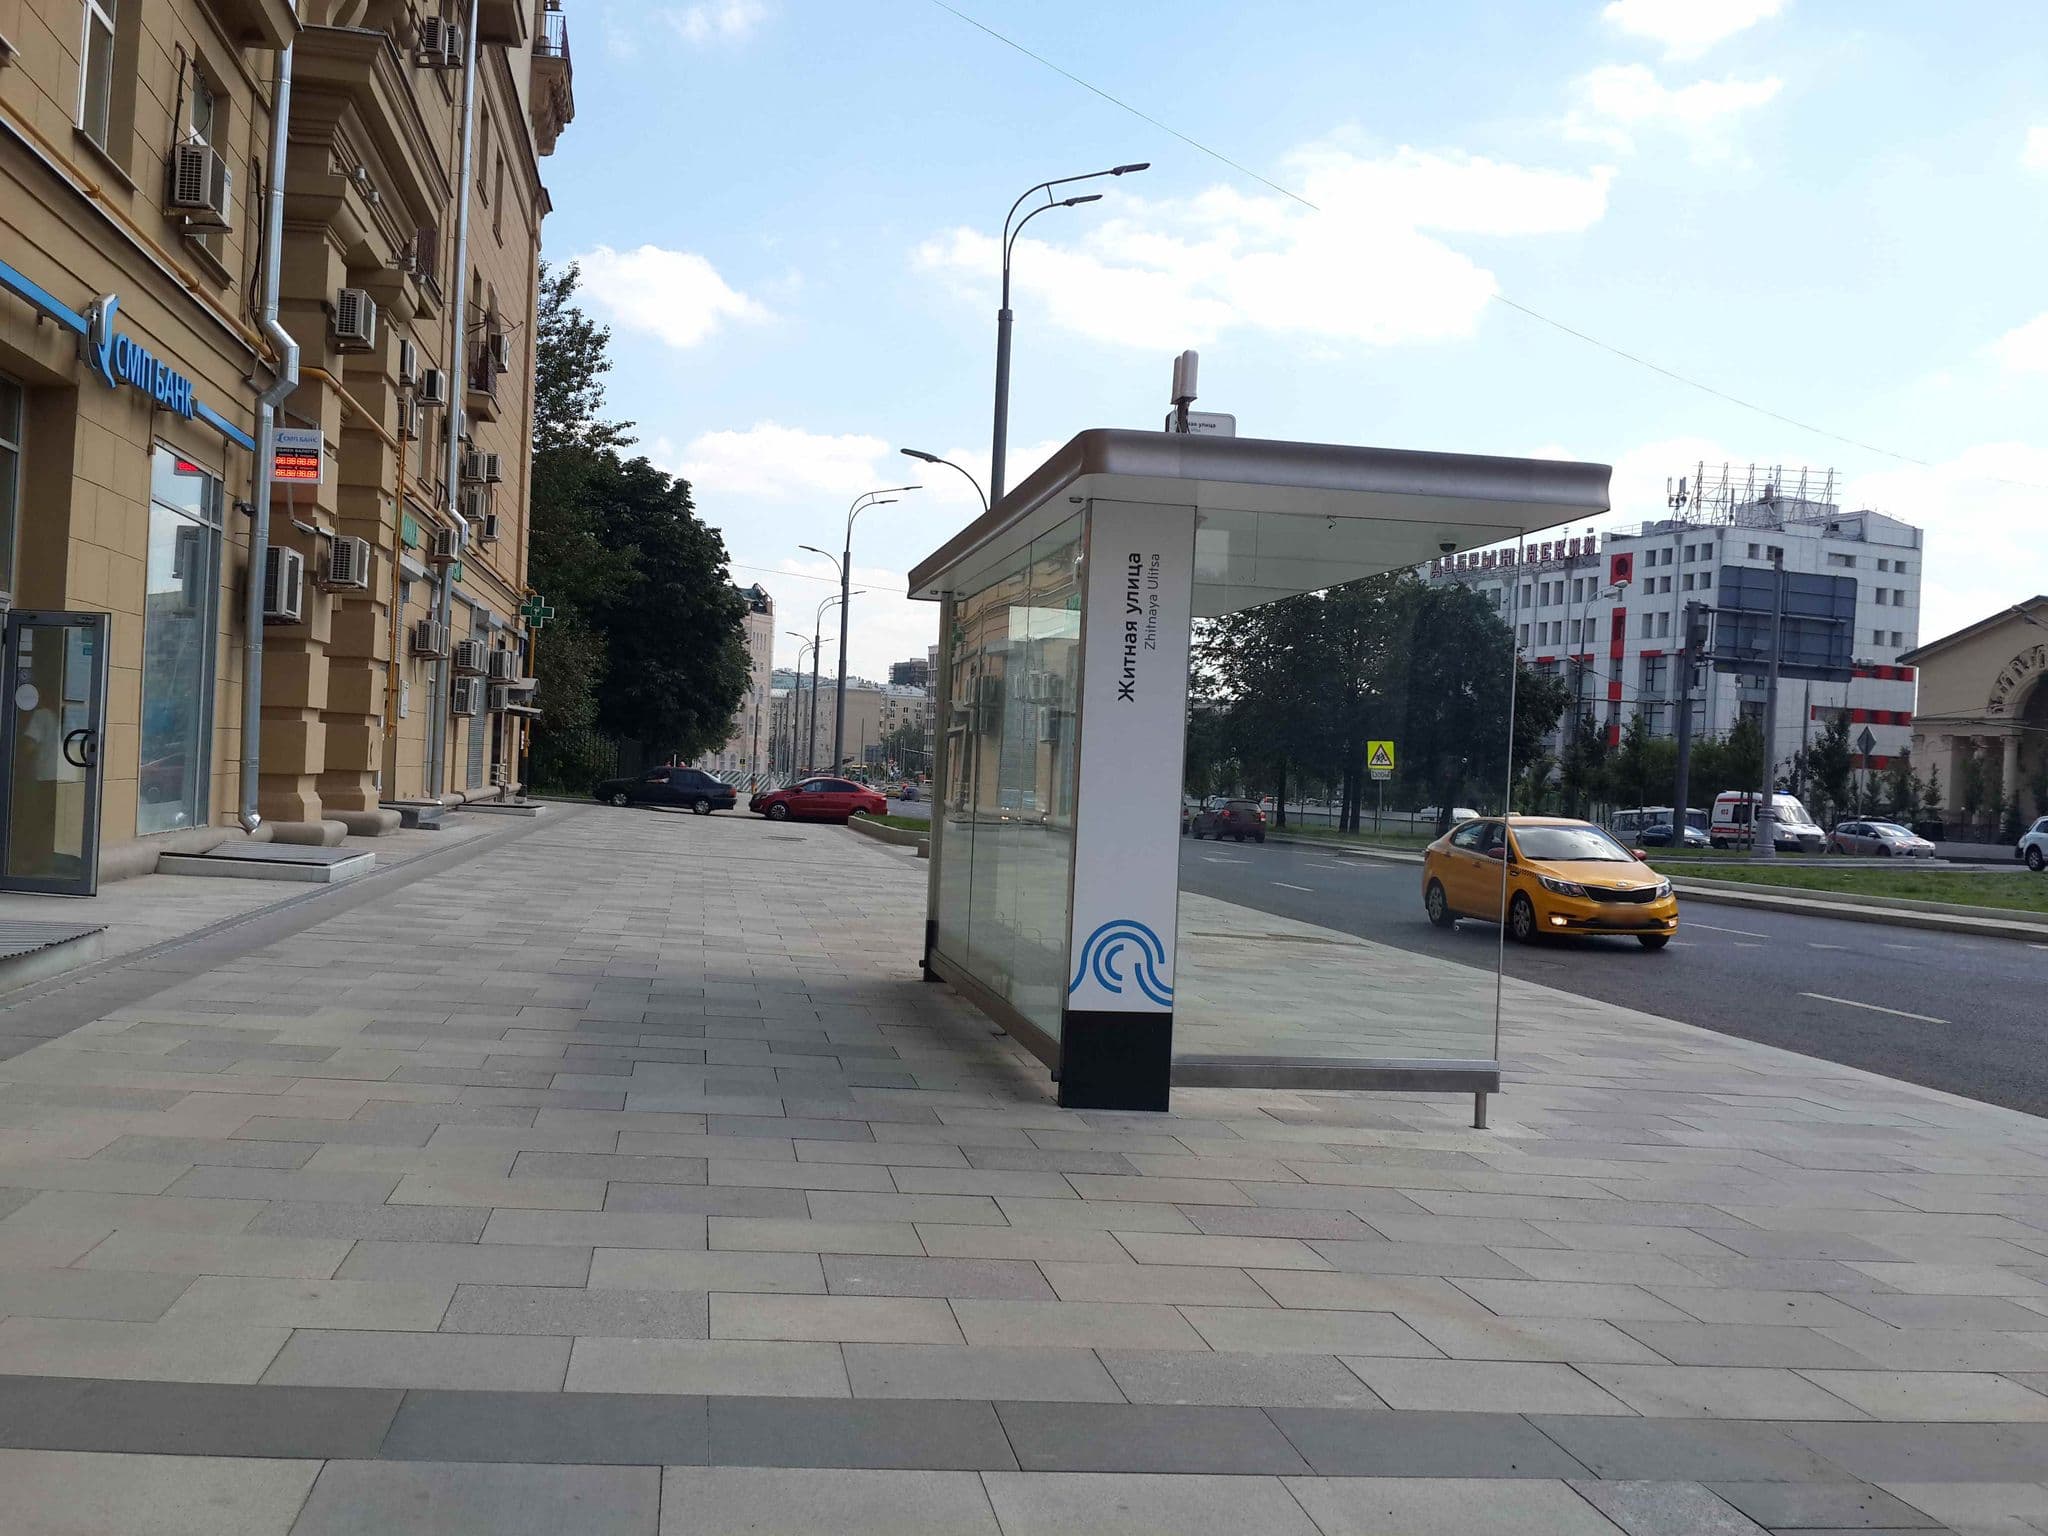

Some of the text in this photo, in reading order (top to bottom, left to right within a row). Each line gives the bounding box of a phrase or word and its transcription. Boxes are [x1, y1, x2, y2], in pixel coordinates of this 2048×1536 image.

[116, 332, 194, 421] СМП БАНК
[1430, 527, 1597, 579] ДОБРЫННСКИЙ
[1117, 552, 1144, 703] Житная улица
[1144, 553, 1160, 651] Zhitnaya Ulitsa
